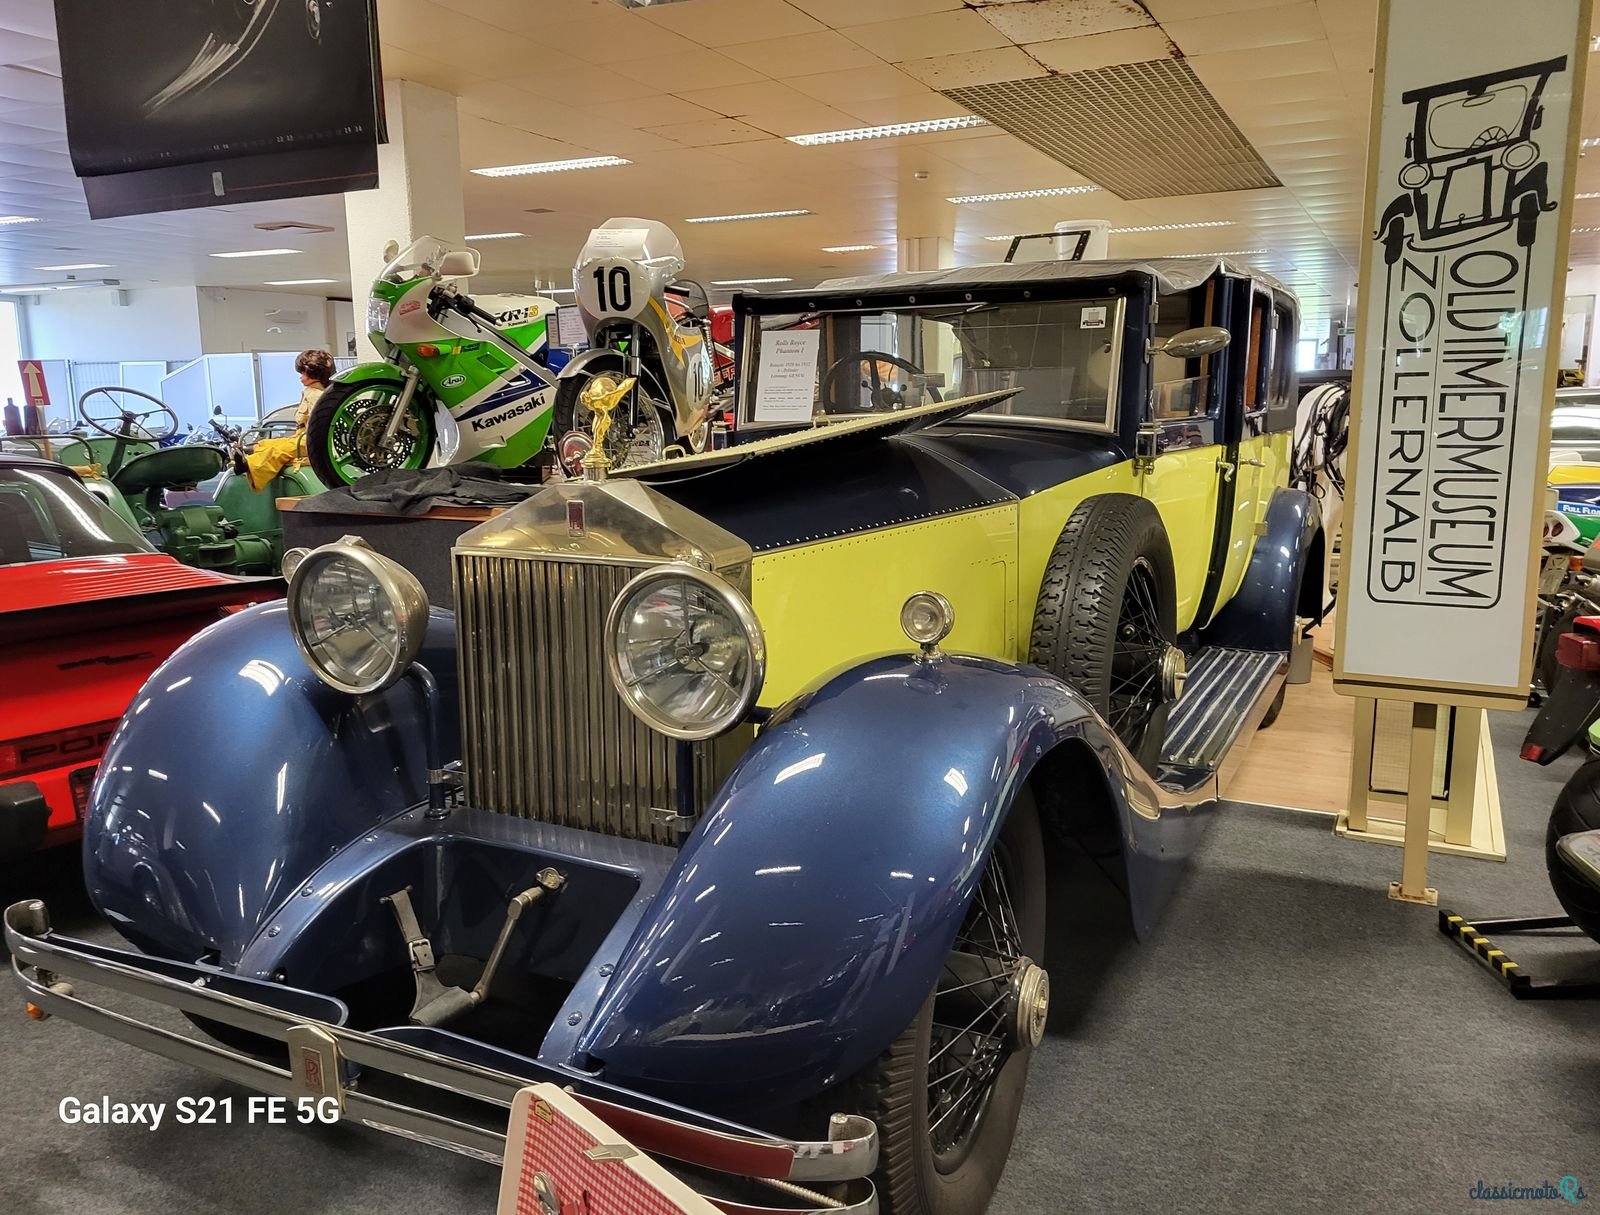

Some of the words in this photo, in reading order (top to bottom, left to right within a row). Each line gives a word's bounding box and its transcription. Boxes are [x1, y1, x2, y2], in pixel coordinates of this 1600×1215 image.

[593, 266, 632, 312] 10
[442, 375, 465, 387] Arai
[471, 393, 546, 432] Kawasaki
[1380, 255, 1439, 593] ZOLLERNALB
[1425, 250, 1520, 599] OLDTIMERMUSEUM
